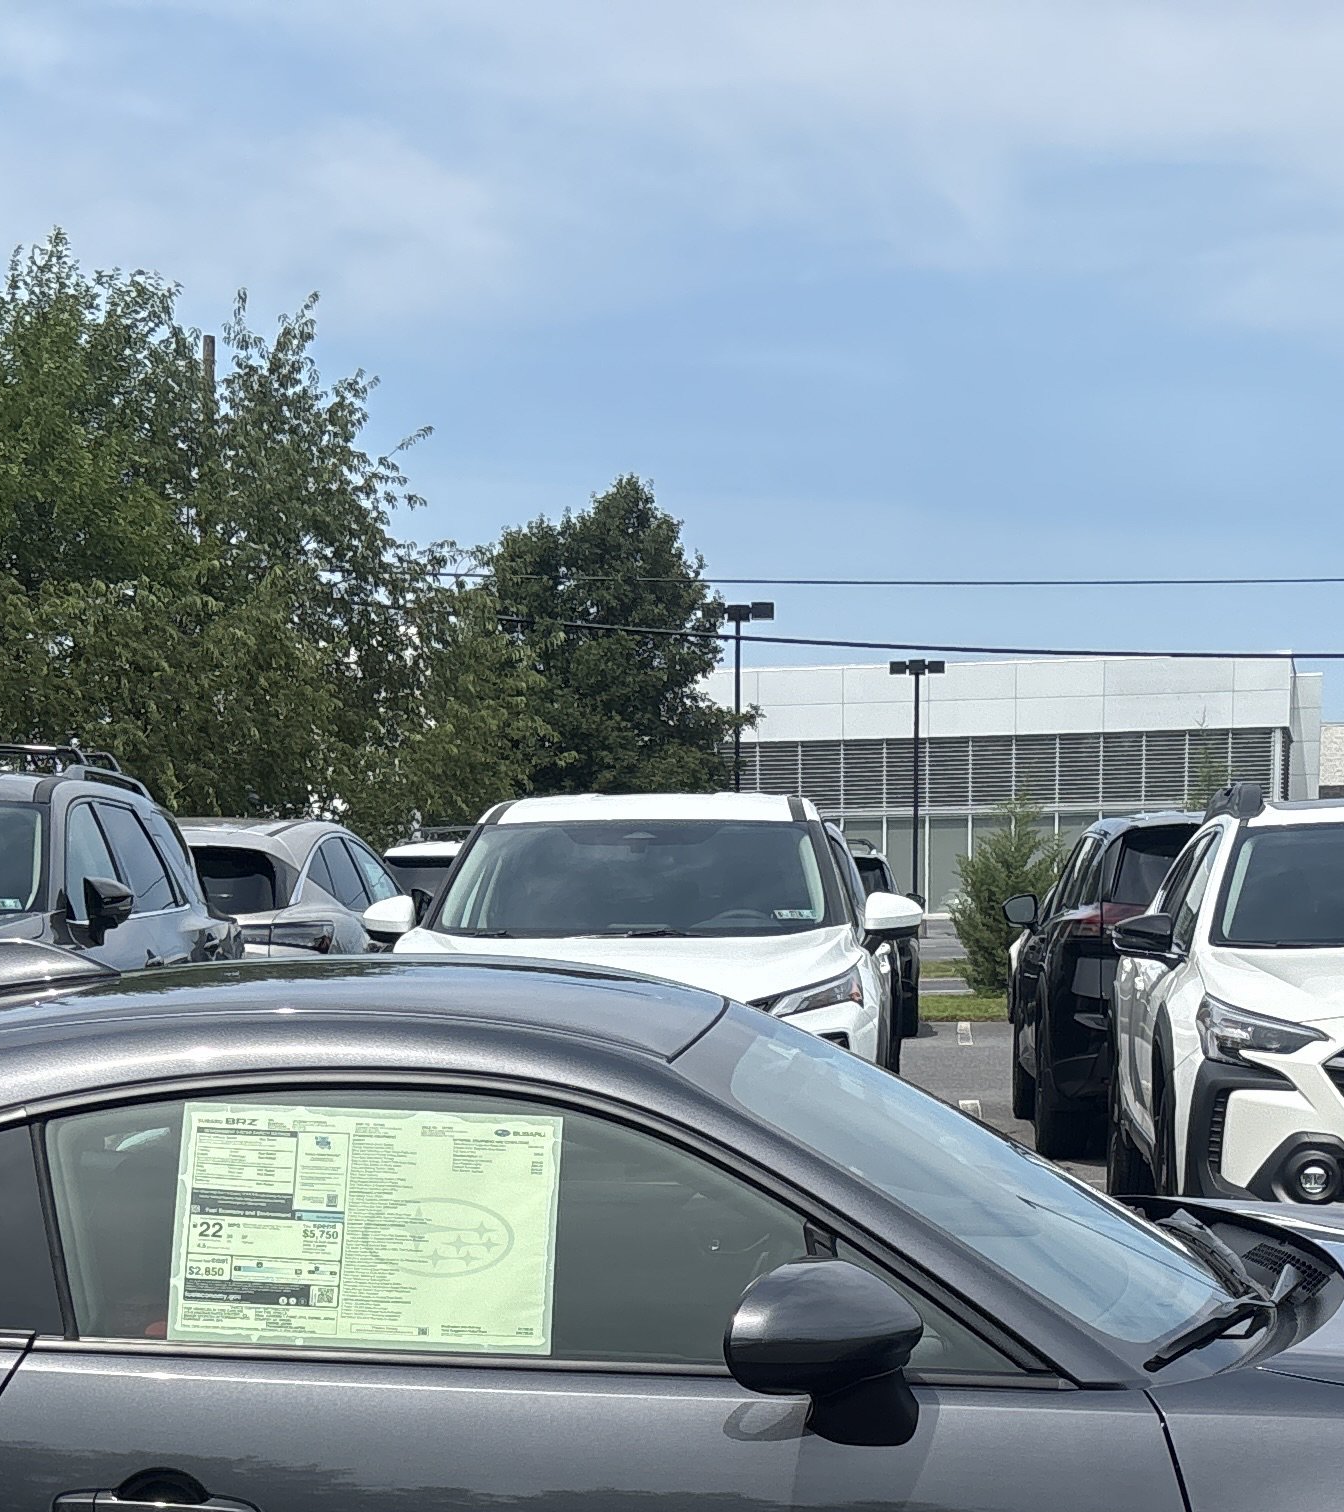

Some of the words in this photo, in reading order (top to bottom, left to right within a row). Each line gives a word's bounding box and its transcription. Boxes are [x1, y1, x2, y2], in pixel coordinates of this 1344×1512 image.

[225, 1117, 259, 1127] BRZ
[198, 1221, 224, 1239] 22
[302, 1228, 339, 1240] $5,750
[188, 1265, 225, 1277] $2,850
